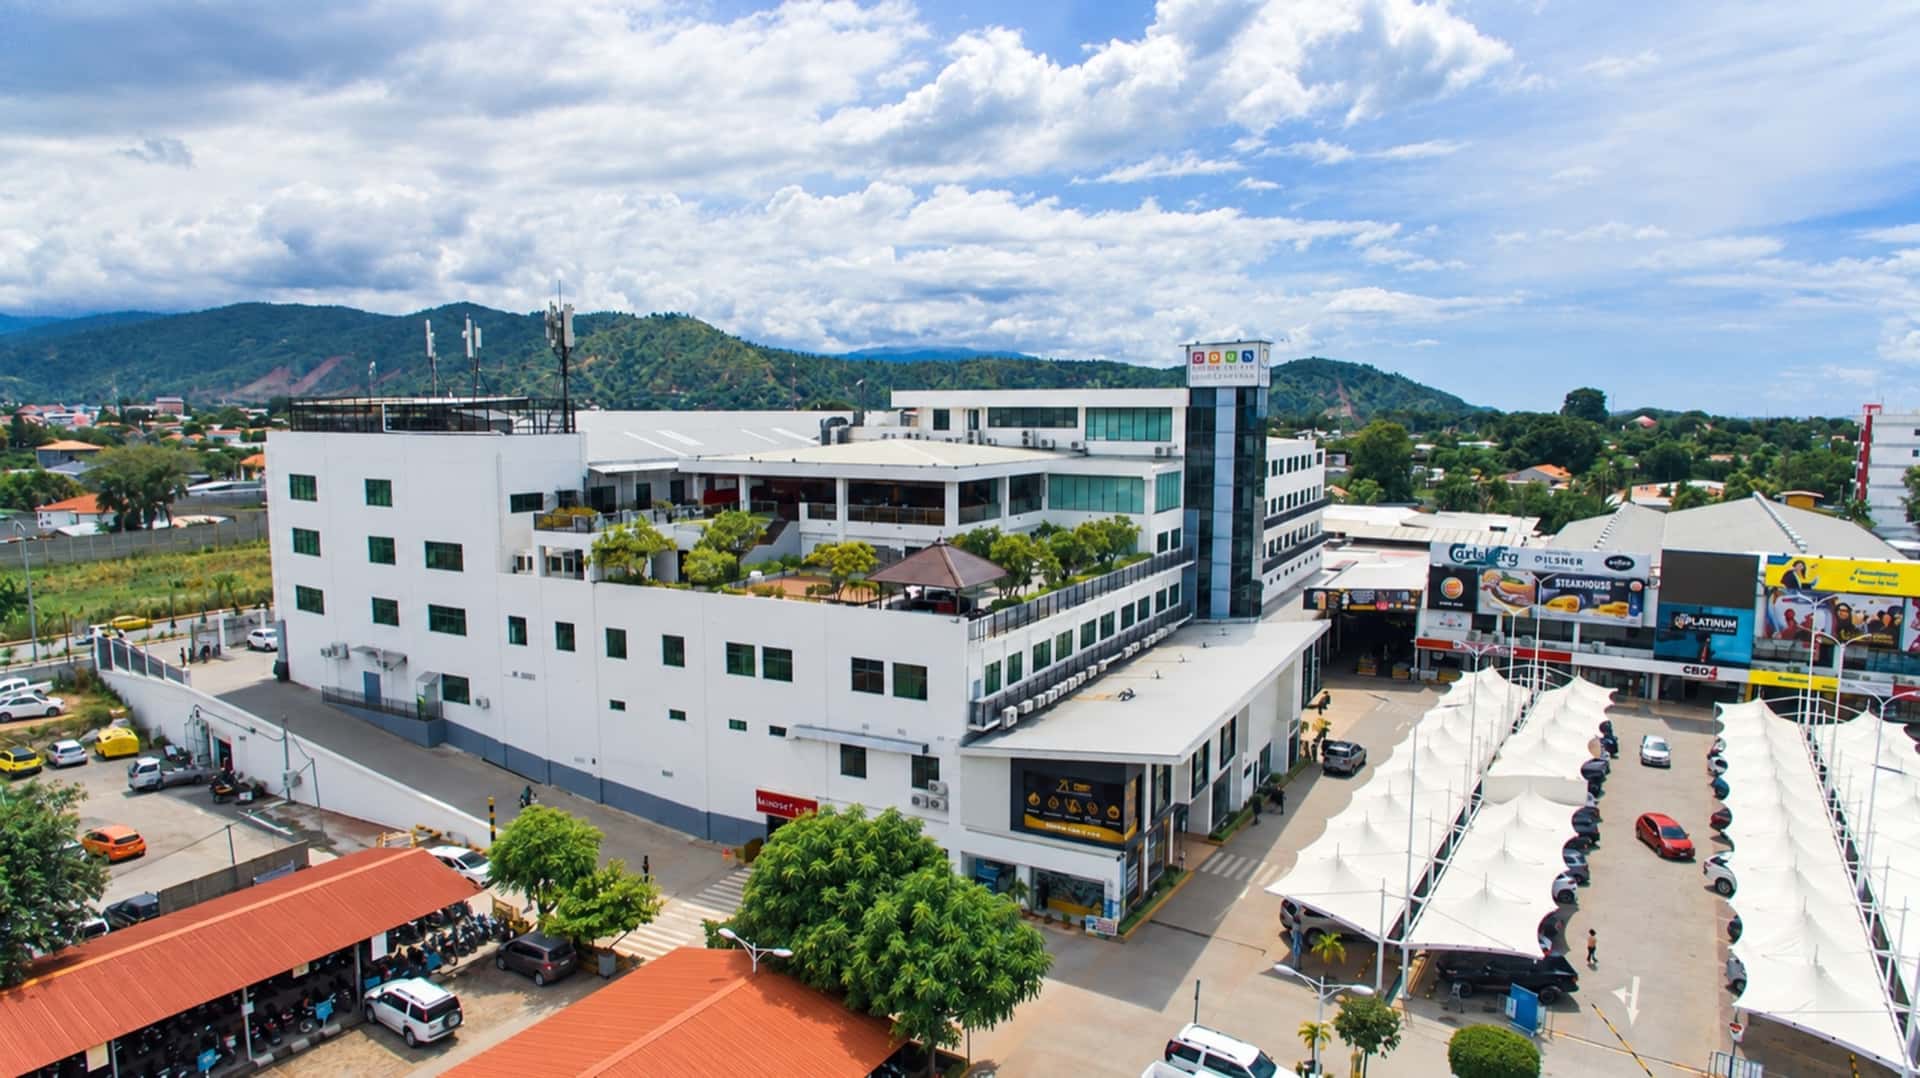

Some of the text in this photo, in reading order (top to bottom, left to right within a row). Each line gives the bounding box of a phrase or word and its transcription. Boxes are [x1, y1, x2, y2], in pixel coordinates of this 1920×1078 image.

[1449, 543, 1519, 567] Carlsberg
[1534, 555, 1584, 566] PILSNER
[1555, 578, 1612, 590] STEAKHOUSE
[1685, 616, 1737, 629] PLATINUM
